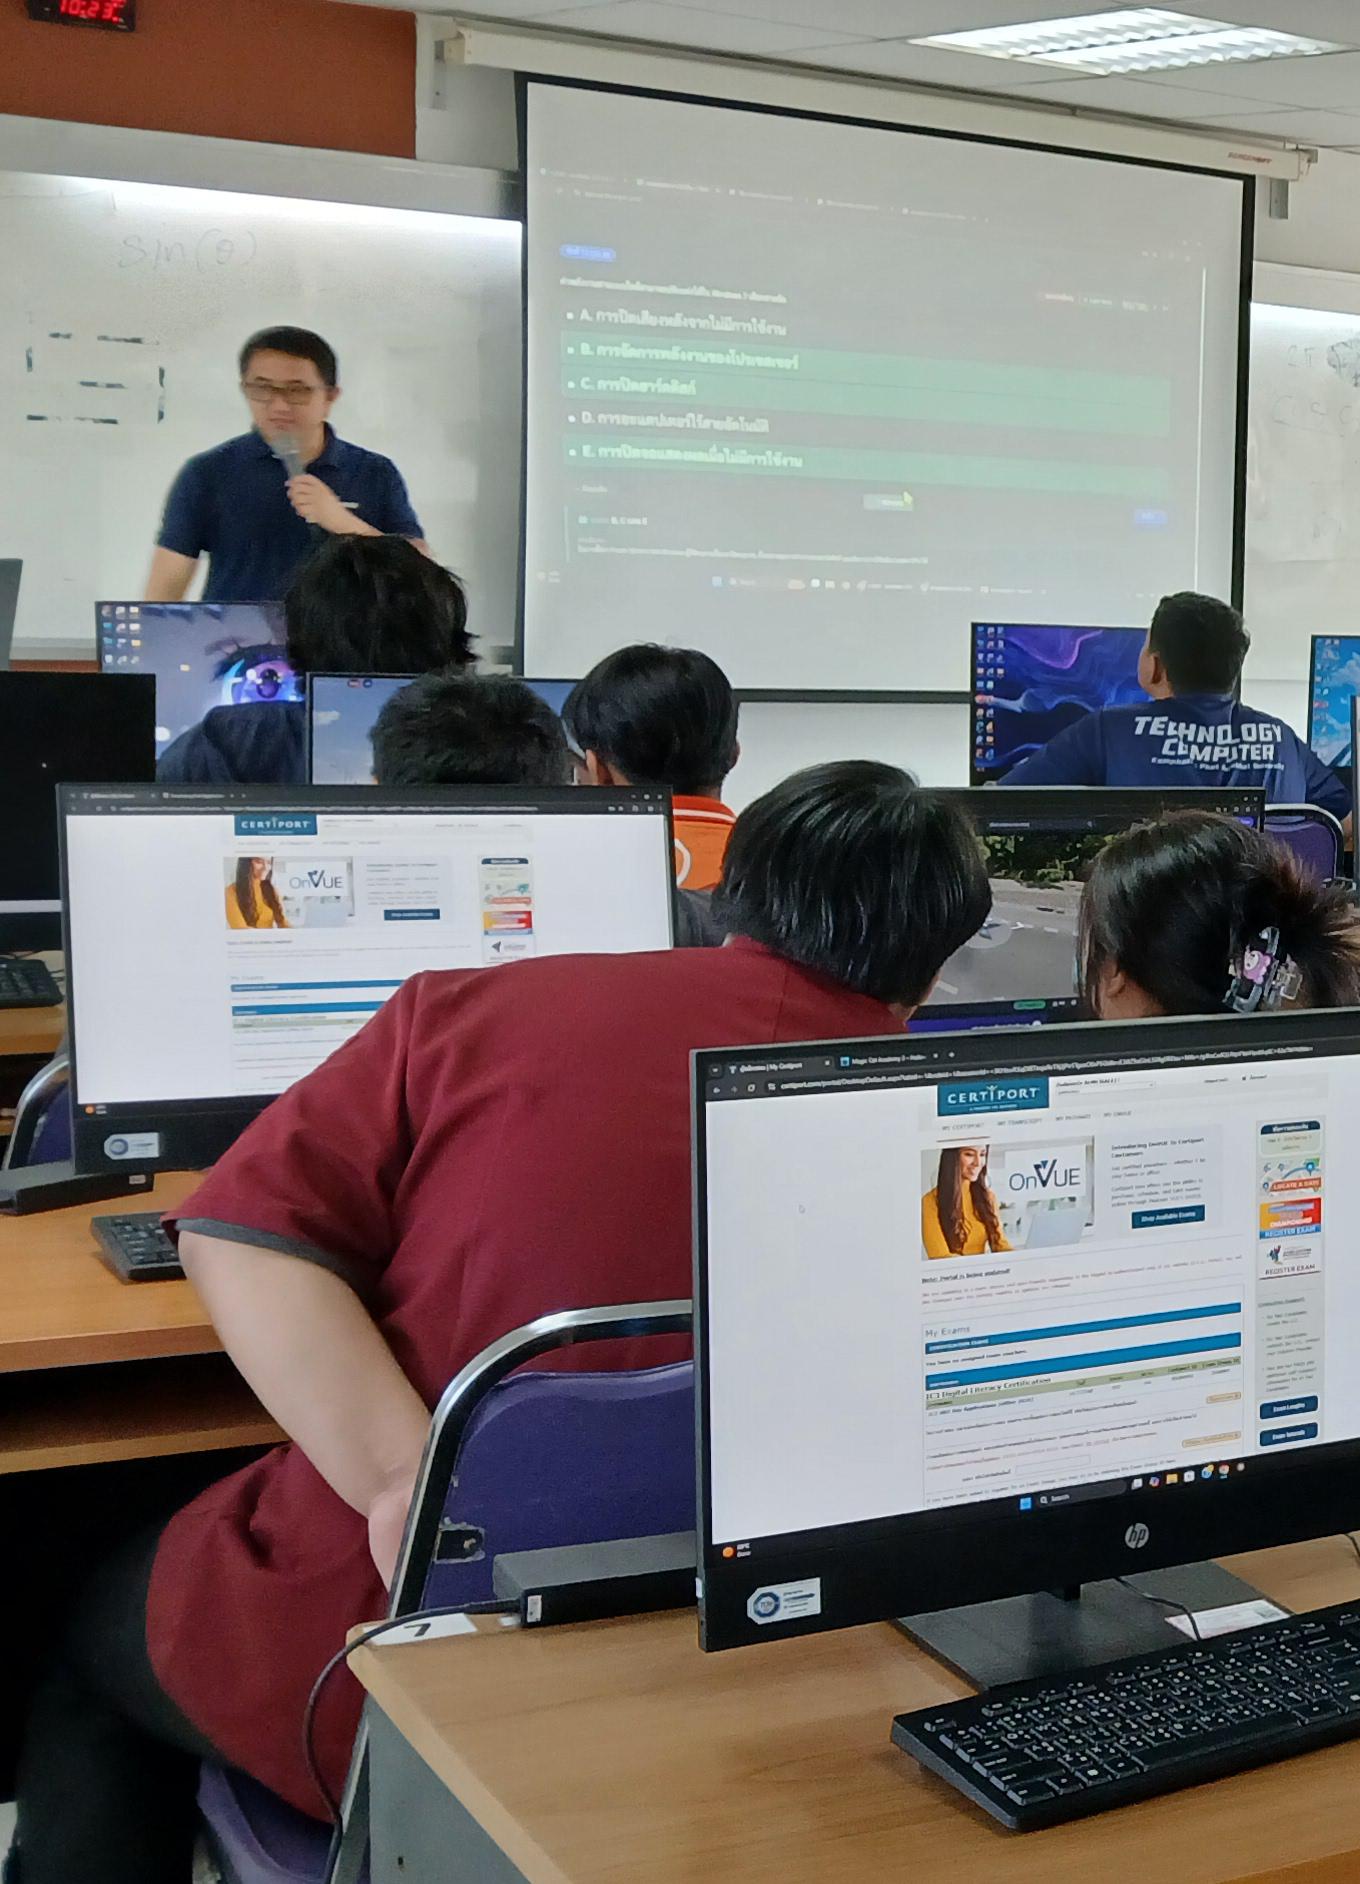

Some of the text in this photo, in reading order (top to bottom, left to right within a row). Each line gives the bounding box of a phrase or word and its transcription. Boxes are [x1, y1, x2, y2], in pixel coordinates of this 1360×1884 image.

[289, 869, 344, 889] OnVUE
[947, 1085, 1038, 1104] CERTIPORT
[1009, 1159, 1081, 1191] OnVUE
[1126, 1524, 1149, 1548] hp
